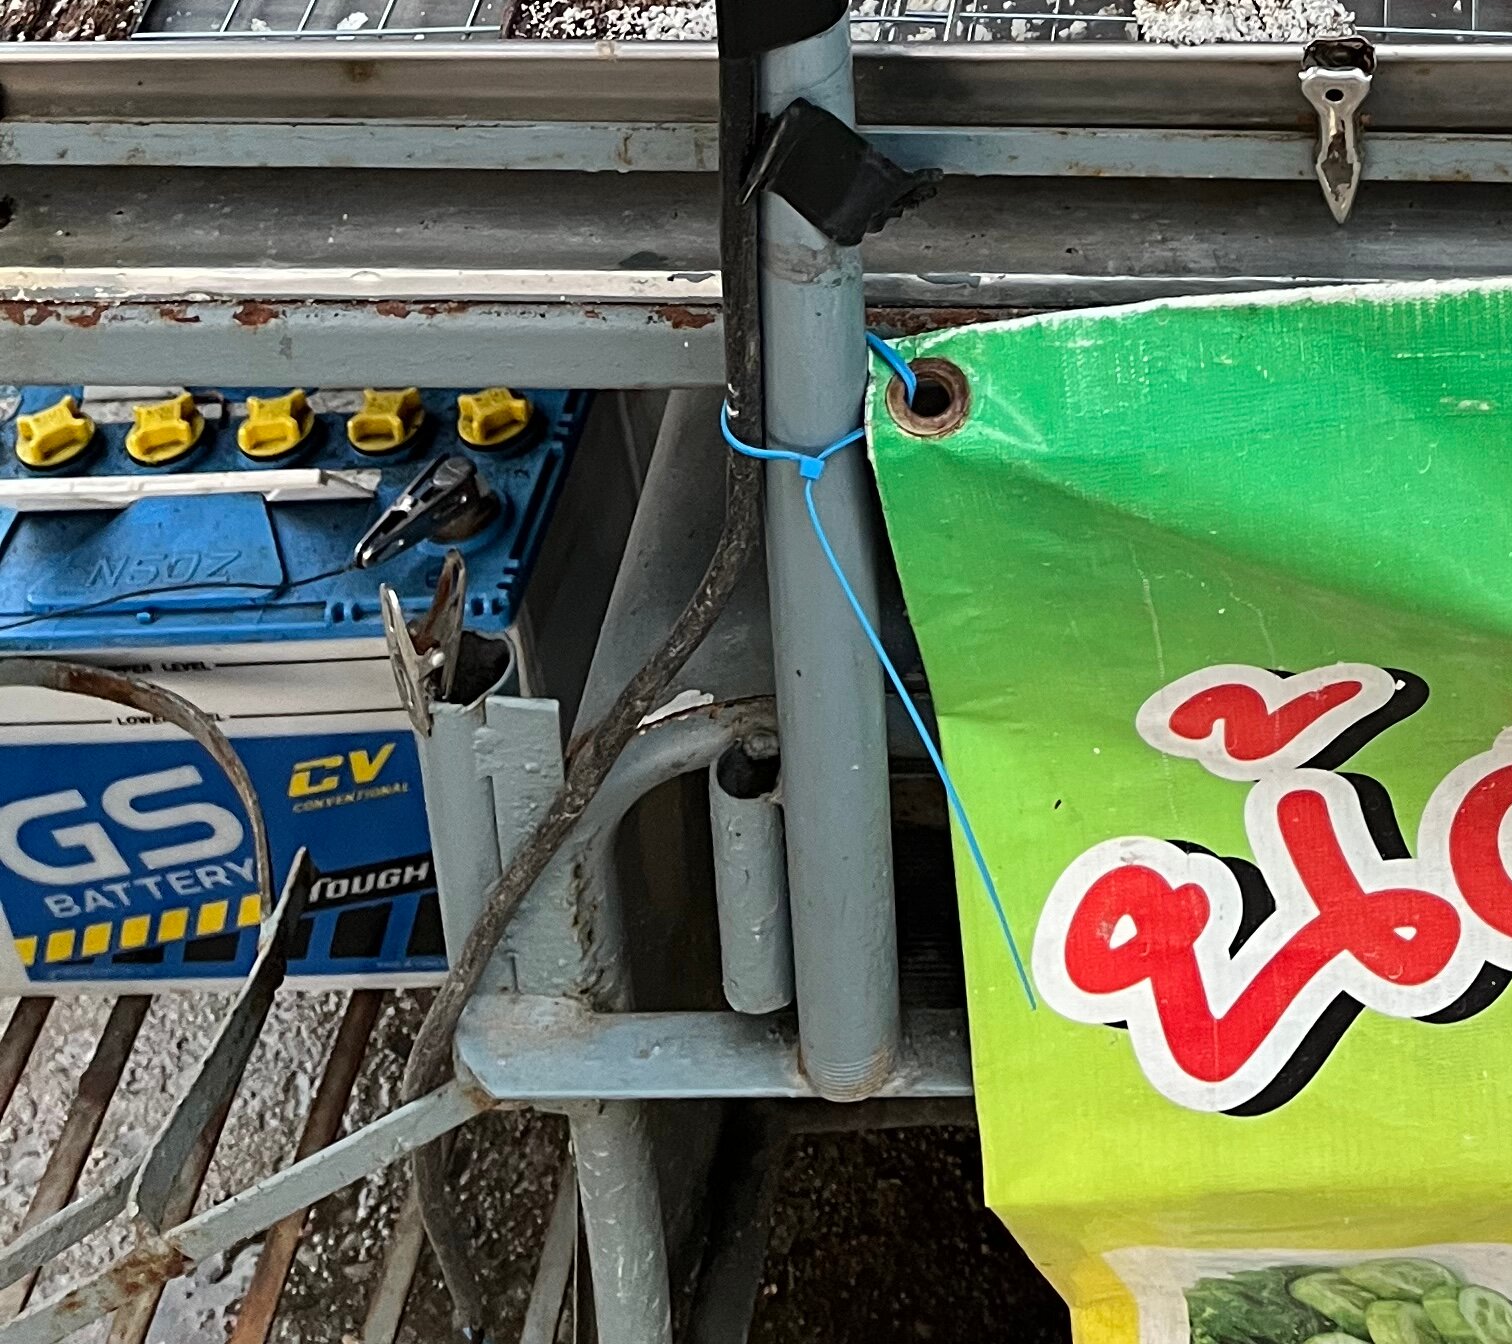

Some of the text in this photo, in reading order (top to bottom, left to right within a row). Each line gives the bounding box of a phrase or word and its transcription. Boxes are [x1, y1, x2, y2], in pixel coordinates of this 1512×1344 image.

[287, 741, 397, 799] CV
[292, 781, 410, 814] CONVENTIONAL
[0, 764, 245, 887] GS
[43, 856, 256, 920] BATTERY
